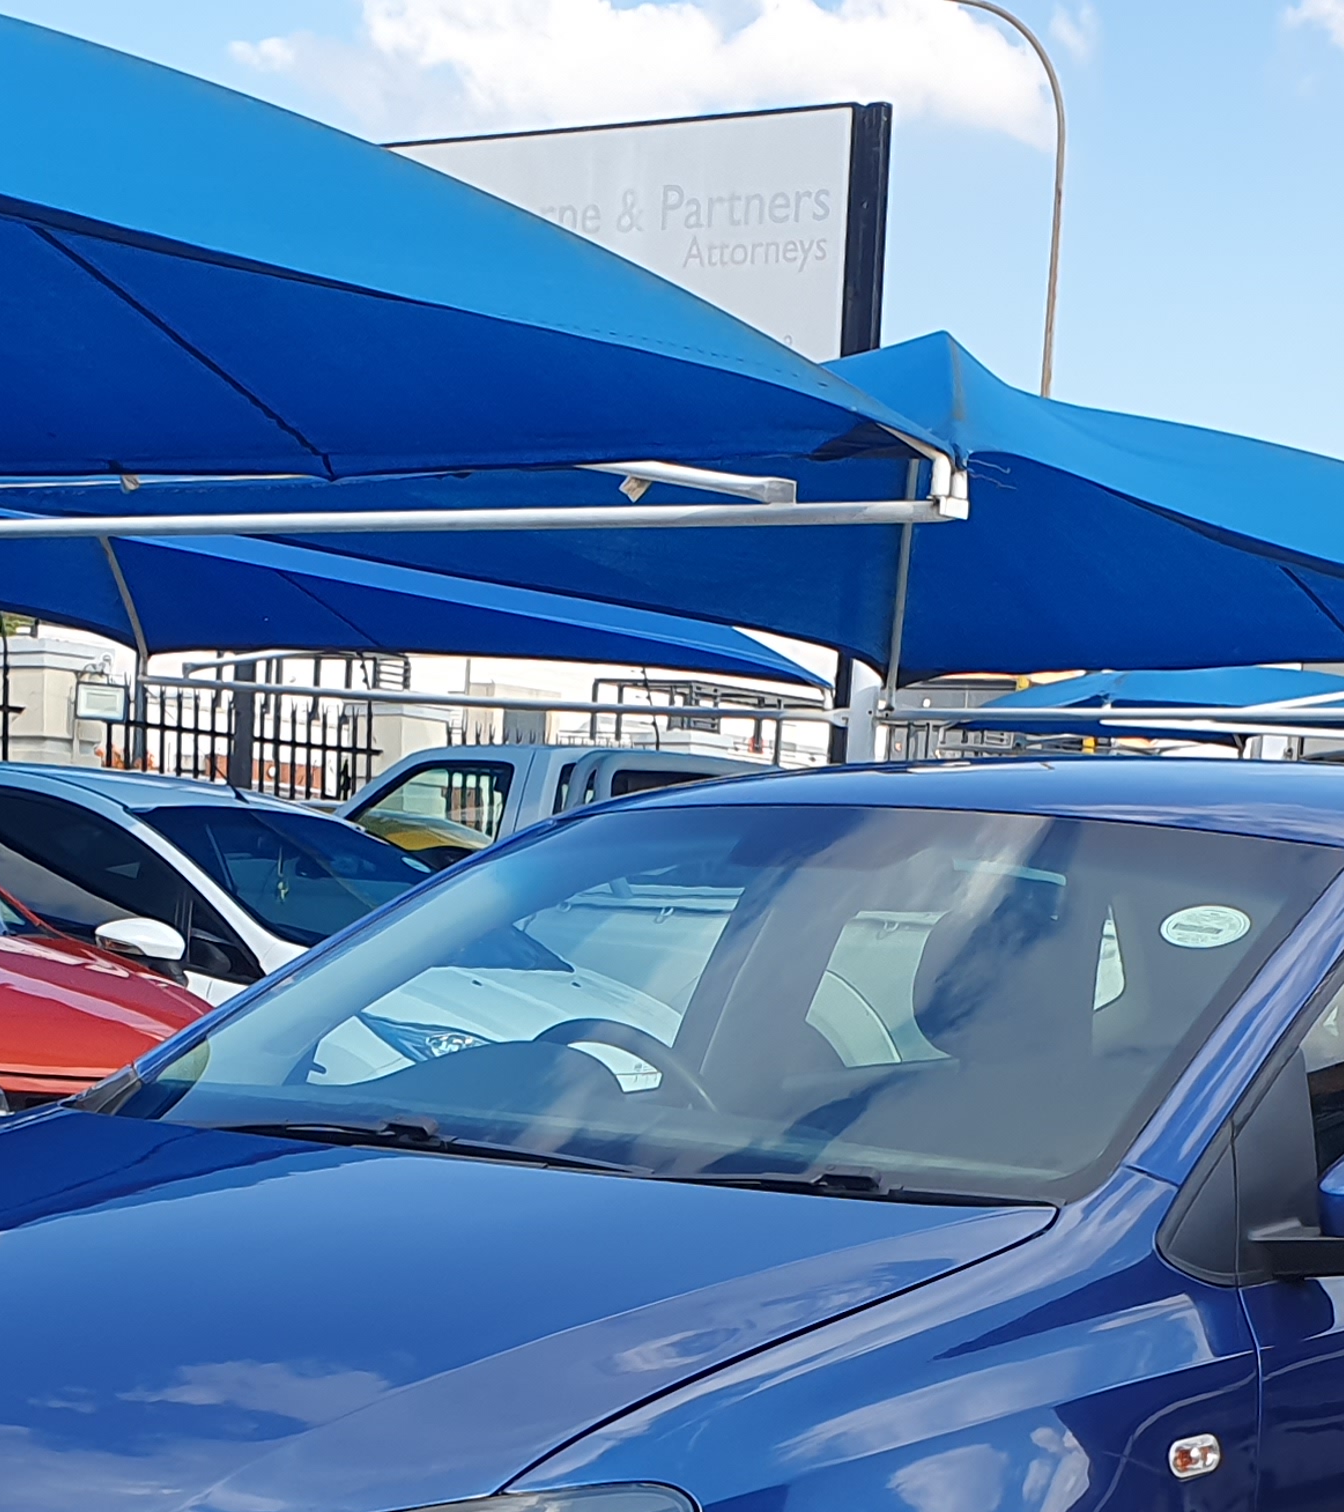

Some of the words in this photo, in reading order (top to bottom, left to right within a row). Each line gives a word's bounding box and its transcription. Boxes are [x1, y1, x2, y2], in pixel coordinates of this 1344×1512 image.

[616, 187, 645, 233] &
[659, 184, 831, 231] Partners
[682, 235, 827, 273] Attorneys
